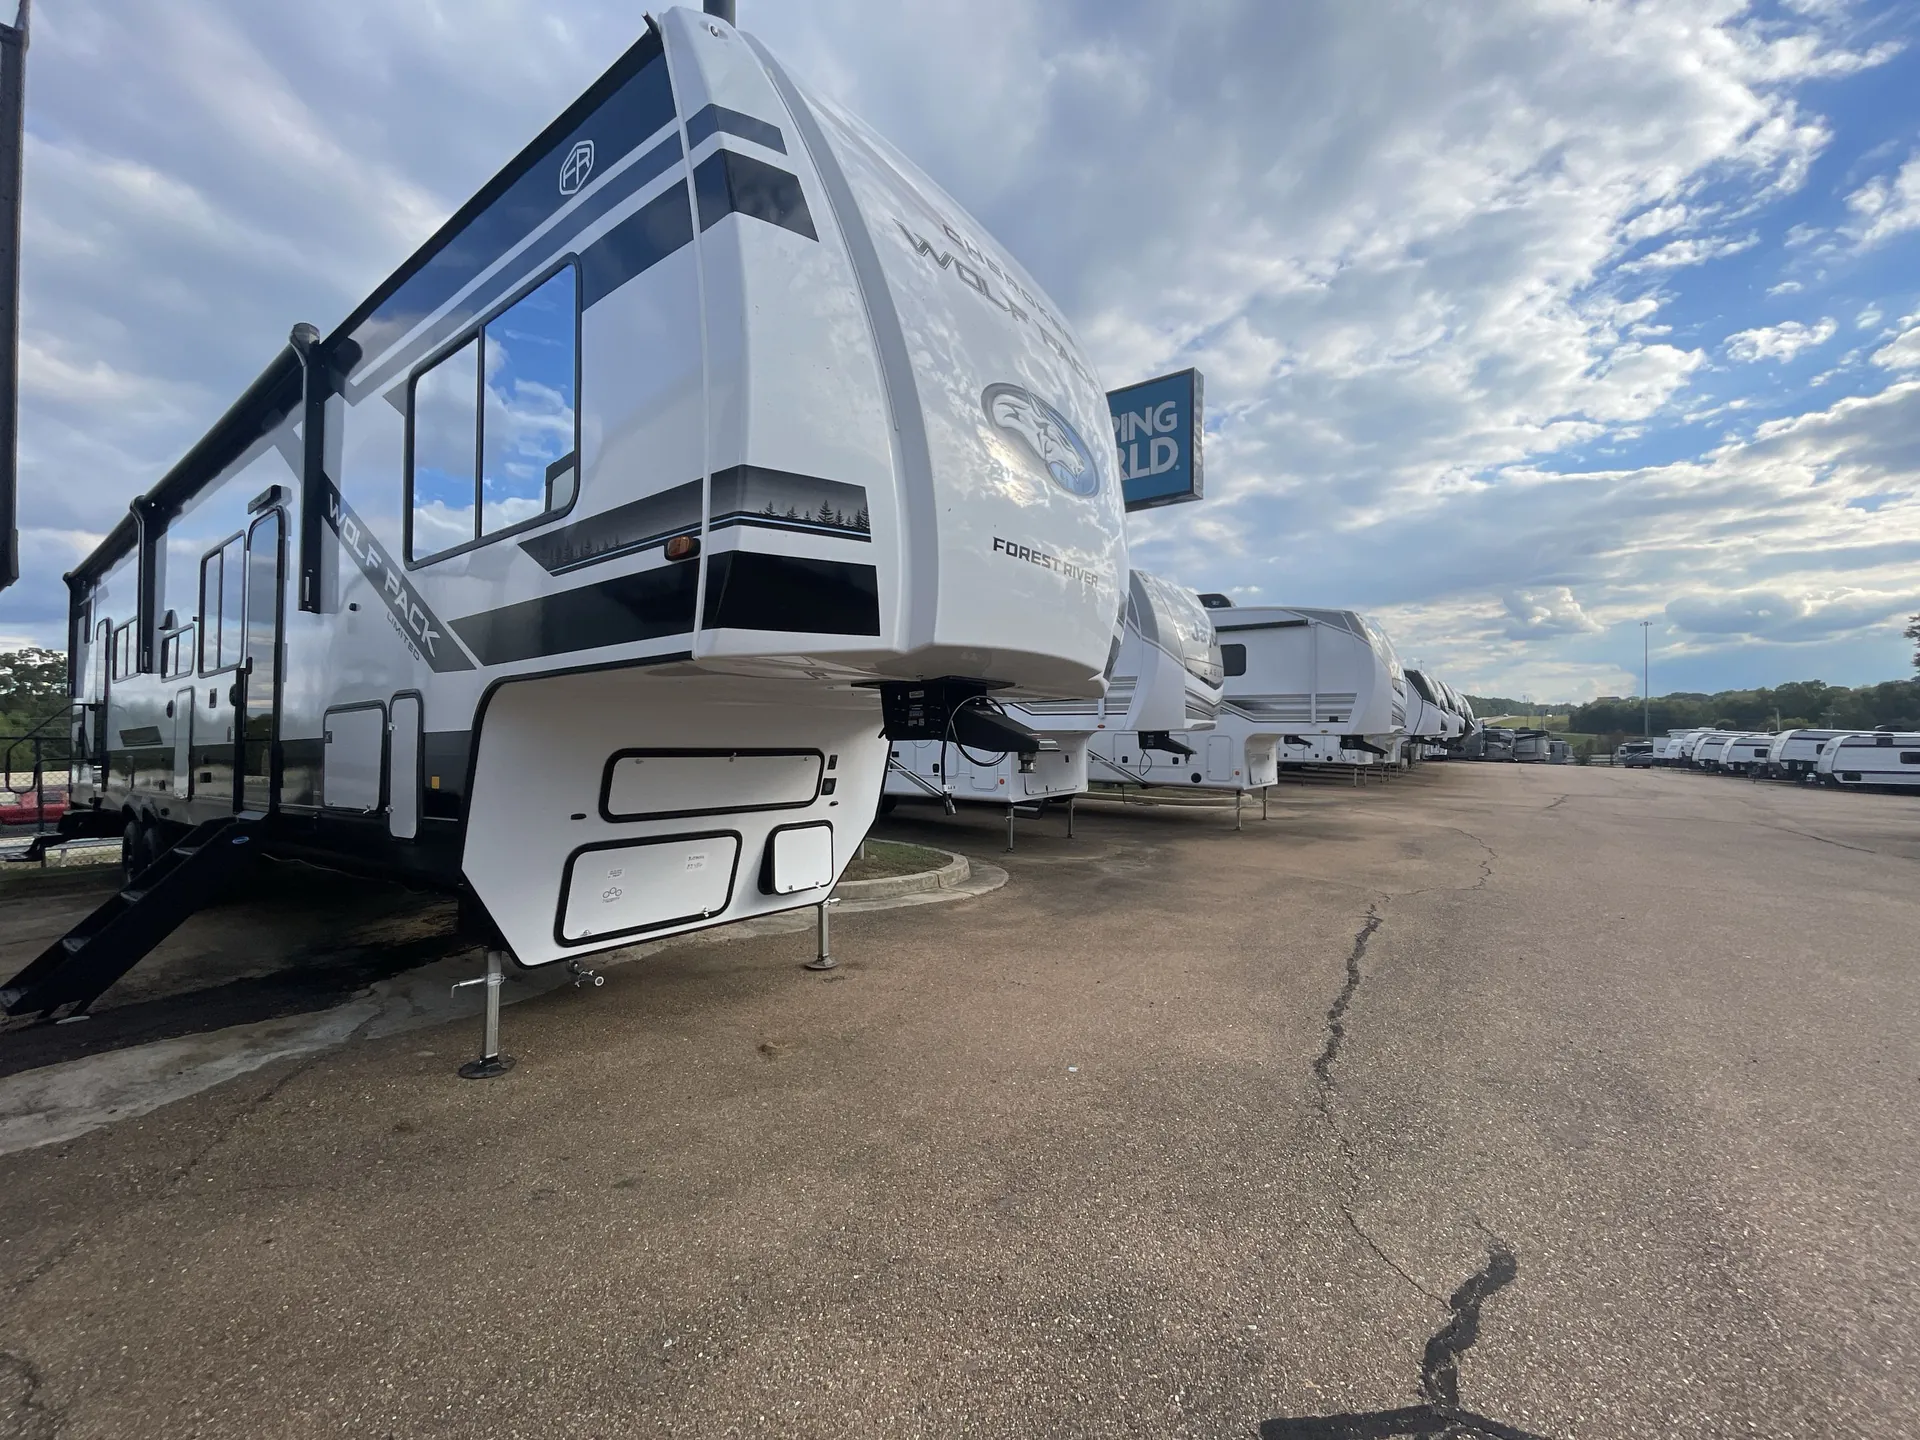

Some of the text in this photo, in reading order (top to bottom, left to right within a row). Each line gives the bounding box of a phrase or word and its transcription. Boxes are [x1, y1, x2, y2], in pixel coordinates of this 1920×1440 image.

[892, 218, 1029, 324] WOLF
[329, 493, 441, 658] WOLF PACK
[993, 537, 1099, 587] FOREST RIVER
[387, 611, 420, 661] LIMITED
